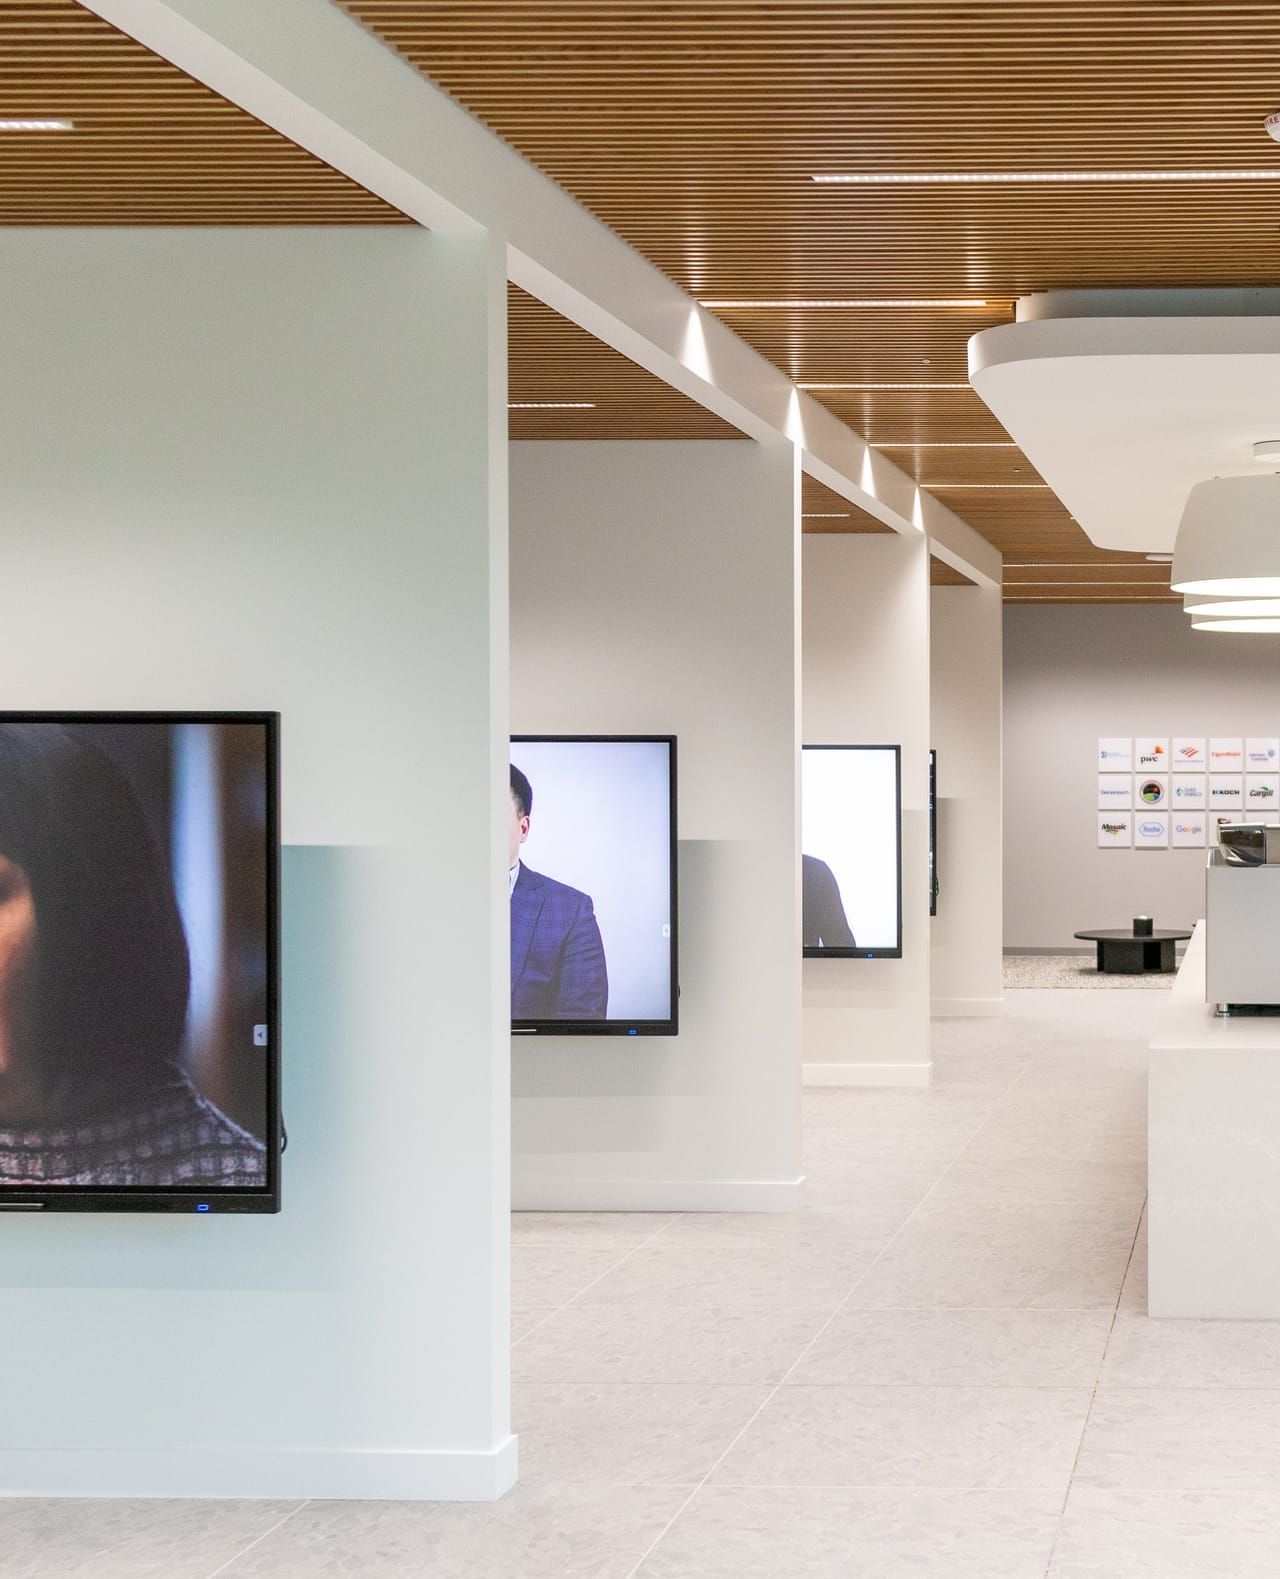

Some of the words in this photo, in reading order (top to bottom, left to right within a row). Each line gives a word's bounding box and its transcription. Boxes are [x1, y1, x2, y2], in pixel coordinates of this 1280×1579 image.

[1140, 756, 1158, 764] pwc
[1249, 789, 1274, 797] Cargill
[1176, 825, 1202, 834] Google
